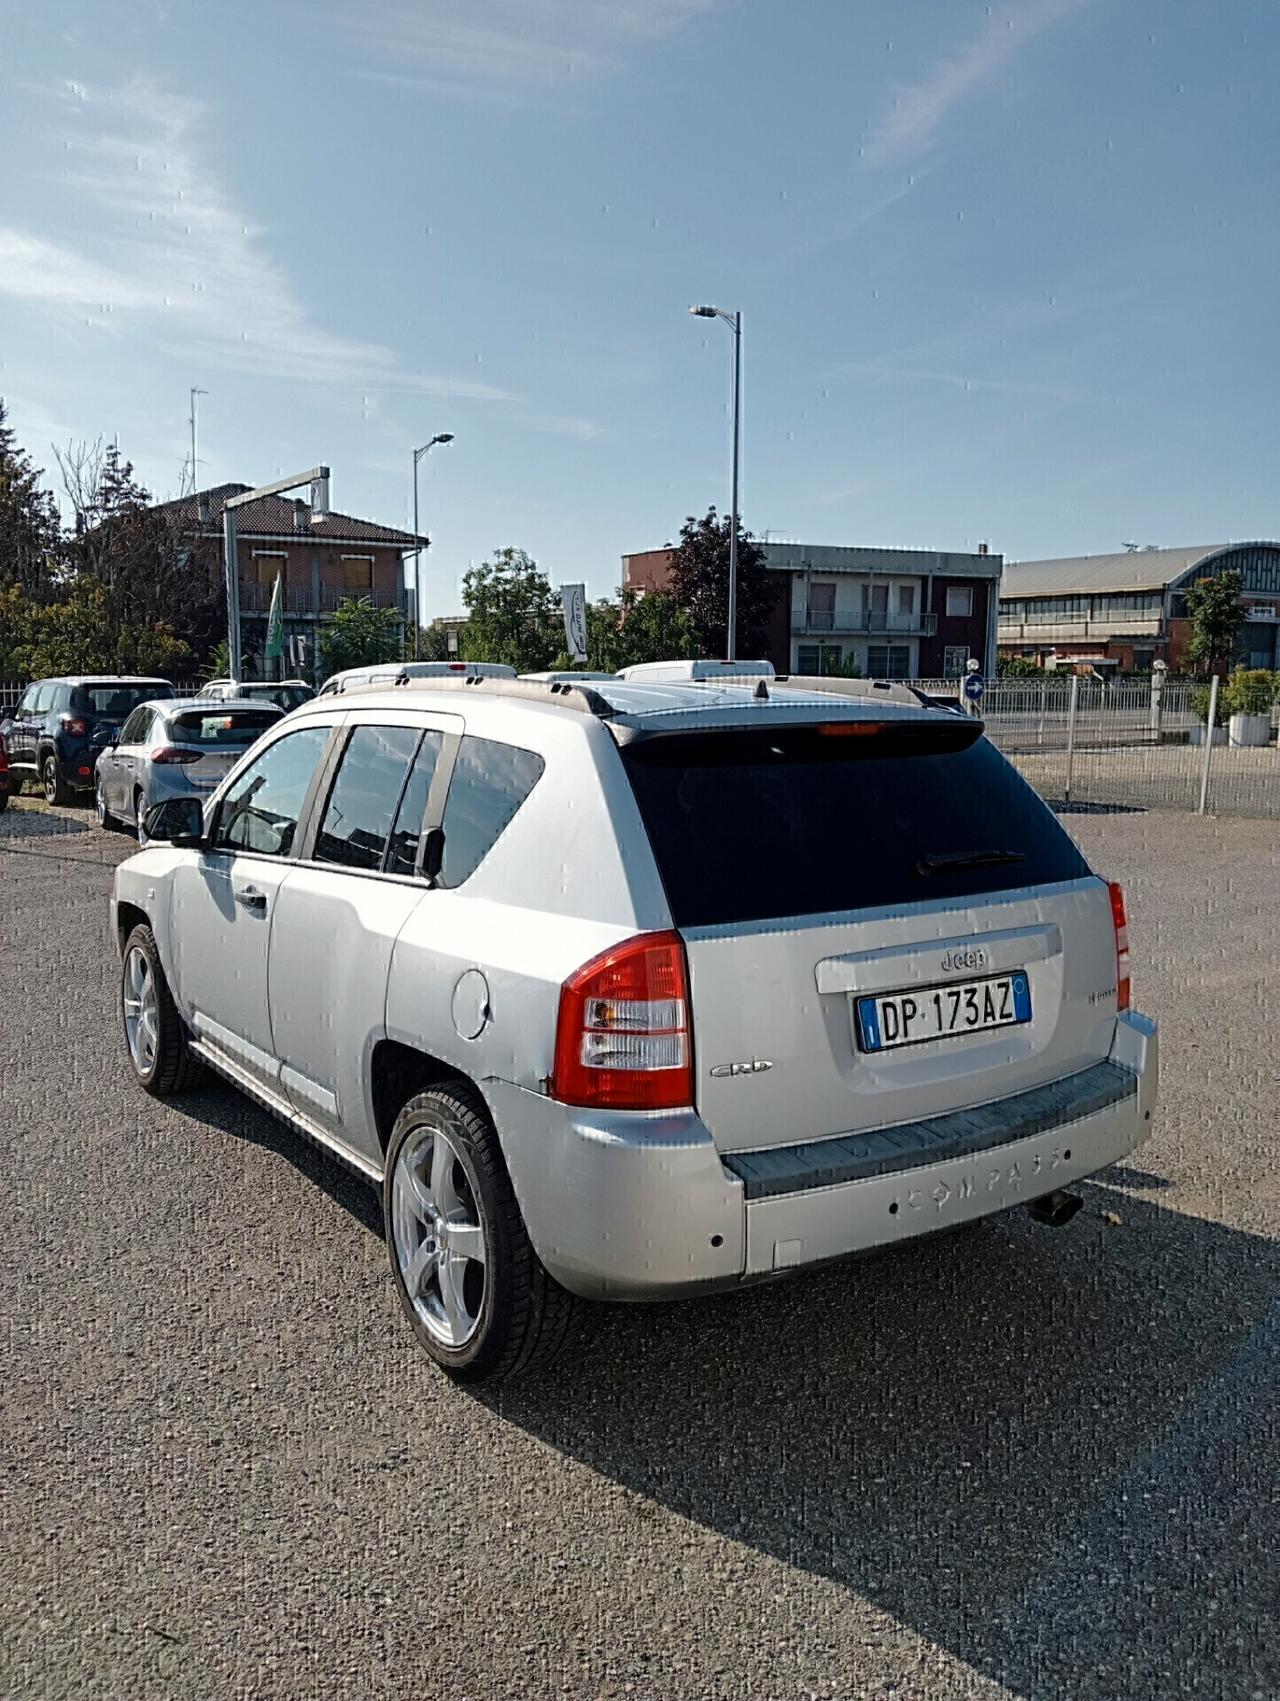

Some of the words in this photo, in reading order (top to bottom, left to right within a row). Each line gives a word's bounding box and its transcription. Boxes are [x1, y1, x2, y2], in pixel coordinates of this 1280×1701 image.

[941, 950, 987, 972] Jeep
[881, 998, 917, 1041] DP
[933, 981, 1013, 1031] 173AZ
[709, 1060, 774, 1077] CRD
[908, 1148, 1062, 1213] COMPASS
